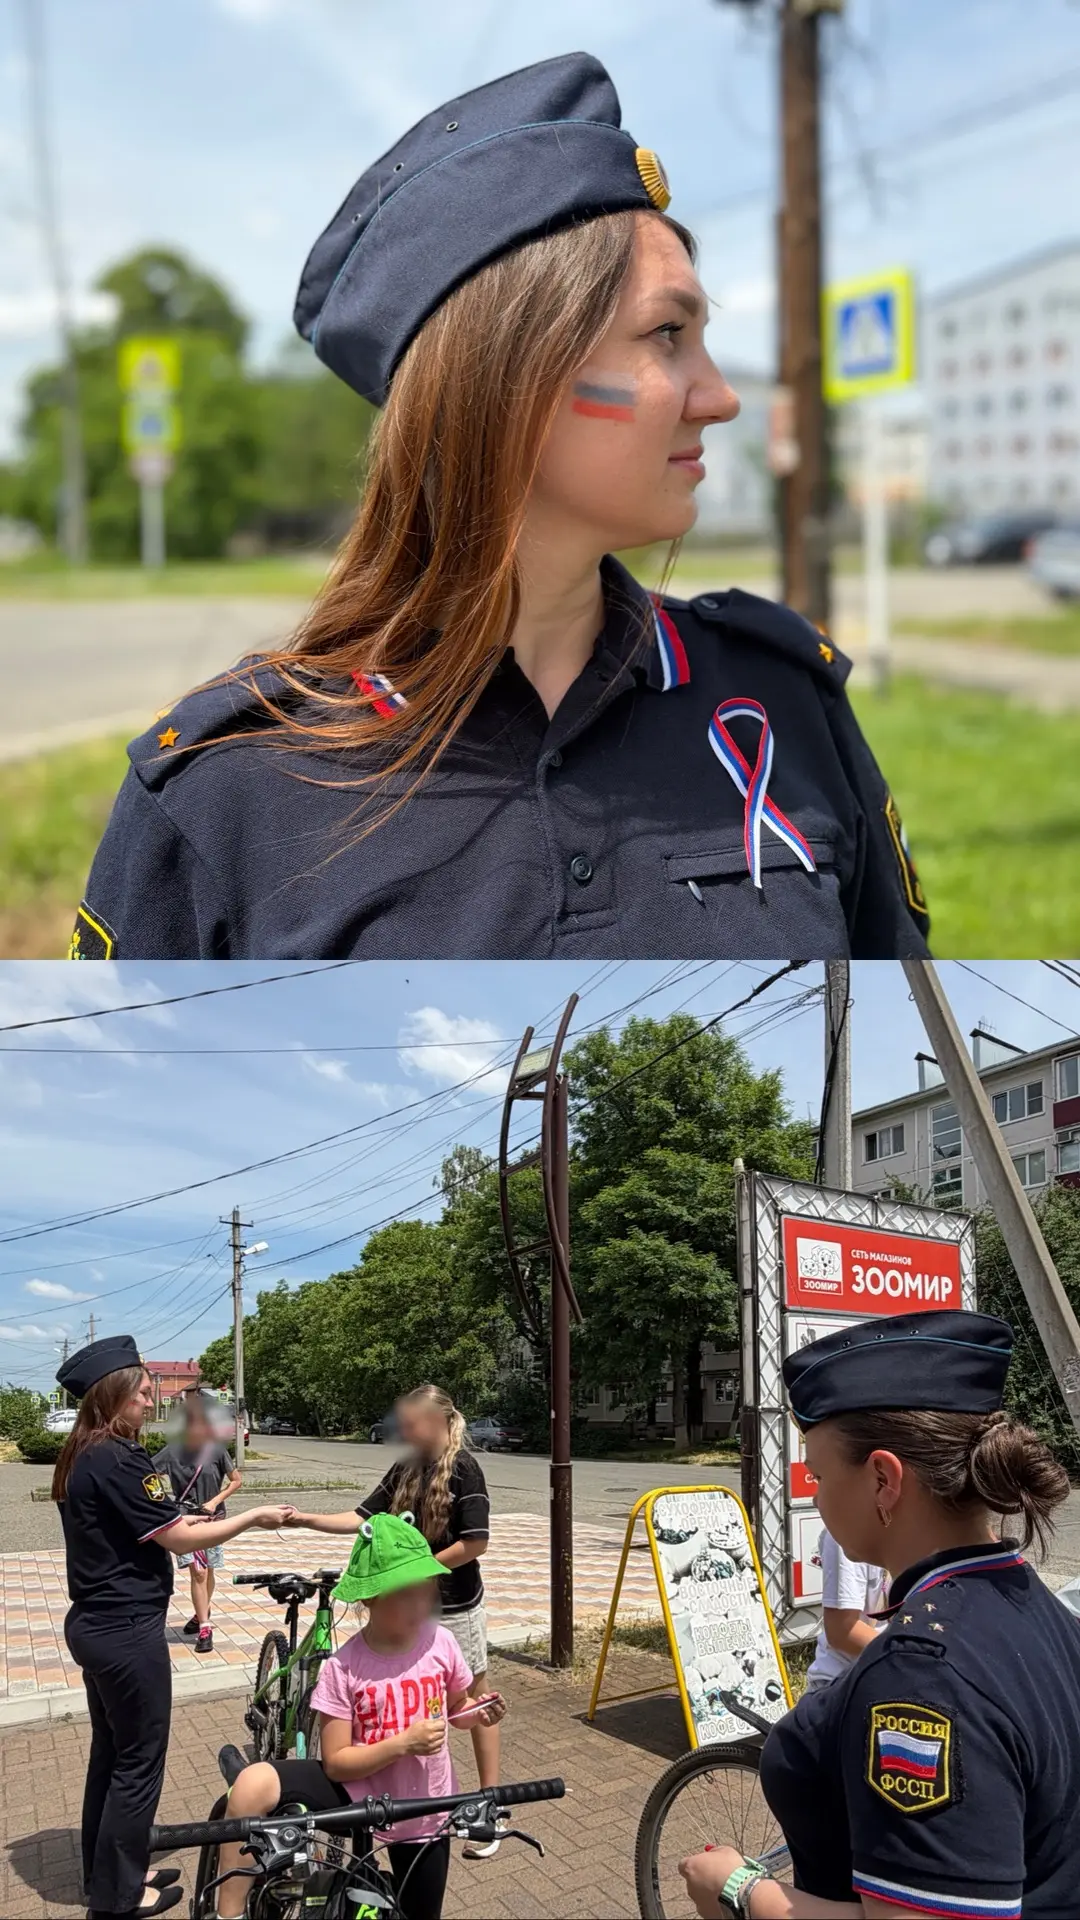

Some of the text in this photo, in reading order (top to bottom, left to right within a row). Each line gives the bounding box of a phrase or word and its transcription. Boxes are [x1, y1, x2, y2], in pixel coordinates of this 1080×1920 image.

[851, 1249, 912, 1266] СЕТЬ МАГАЗИНОВ
[803, 1279, 839, 1292] ЗООМИР
[851, 1265, 953, 1302] ЗООМИР
[659, 1500, 737, 1517] СУХОФРУКТЫ
[681, 1516, 720, 1530] ОРЕХИ
[679, 1577, 754, 1600] ВОСТОЧНЫЕ
[693, 1618, 753, 1641] КОНФЕТЫ
[696, 1634, 757, 1657] ВЫПЕЧКА
[700, 1718, 736, 1740] КОФЕ
[874, 1713, 947, 1739] РОССИЯ
[880, 1773, 935, 1799] ФССП
